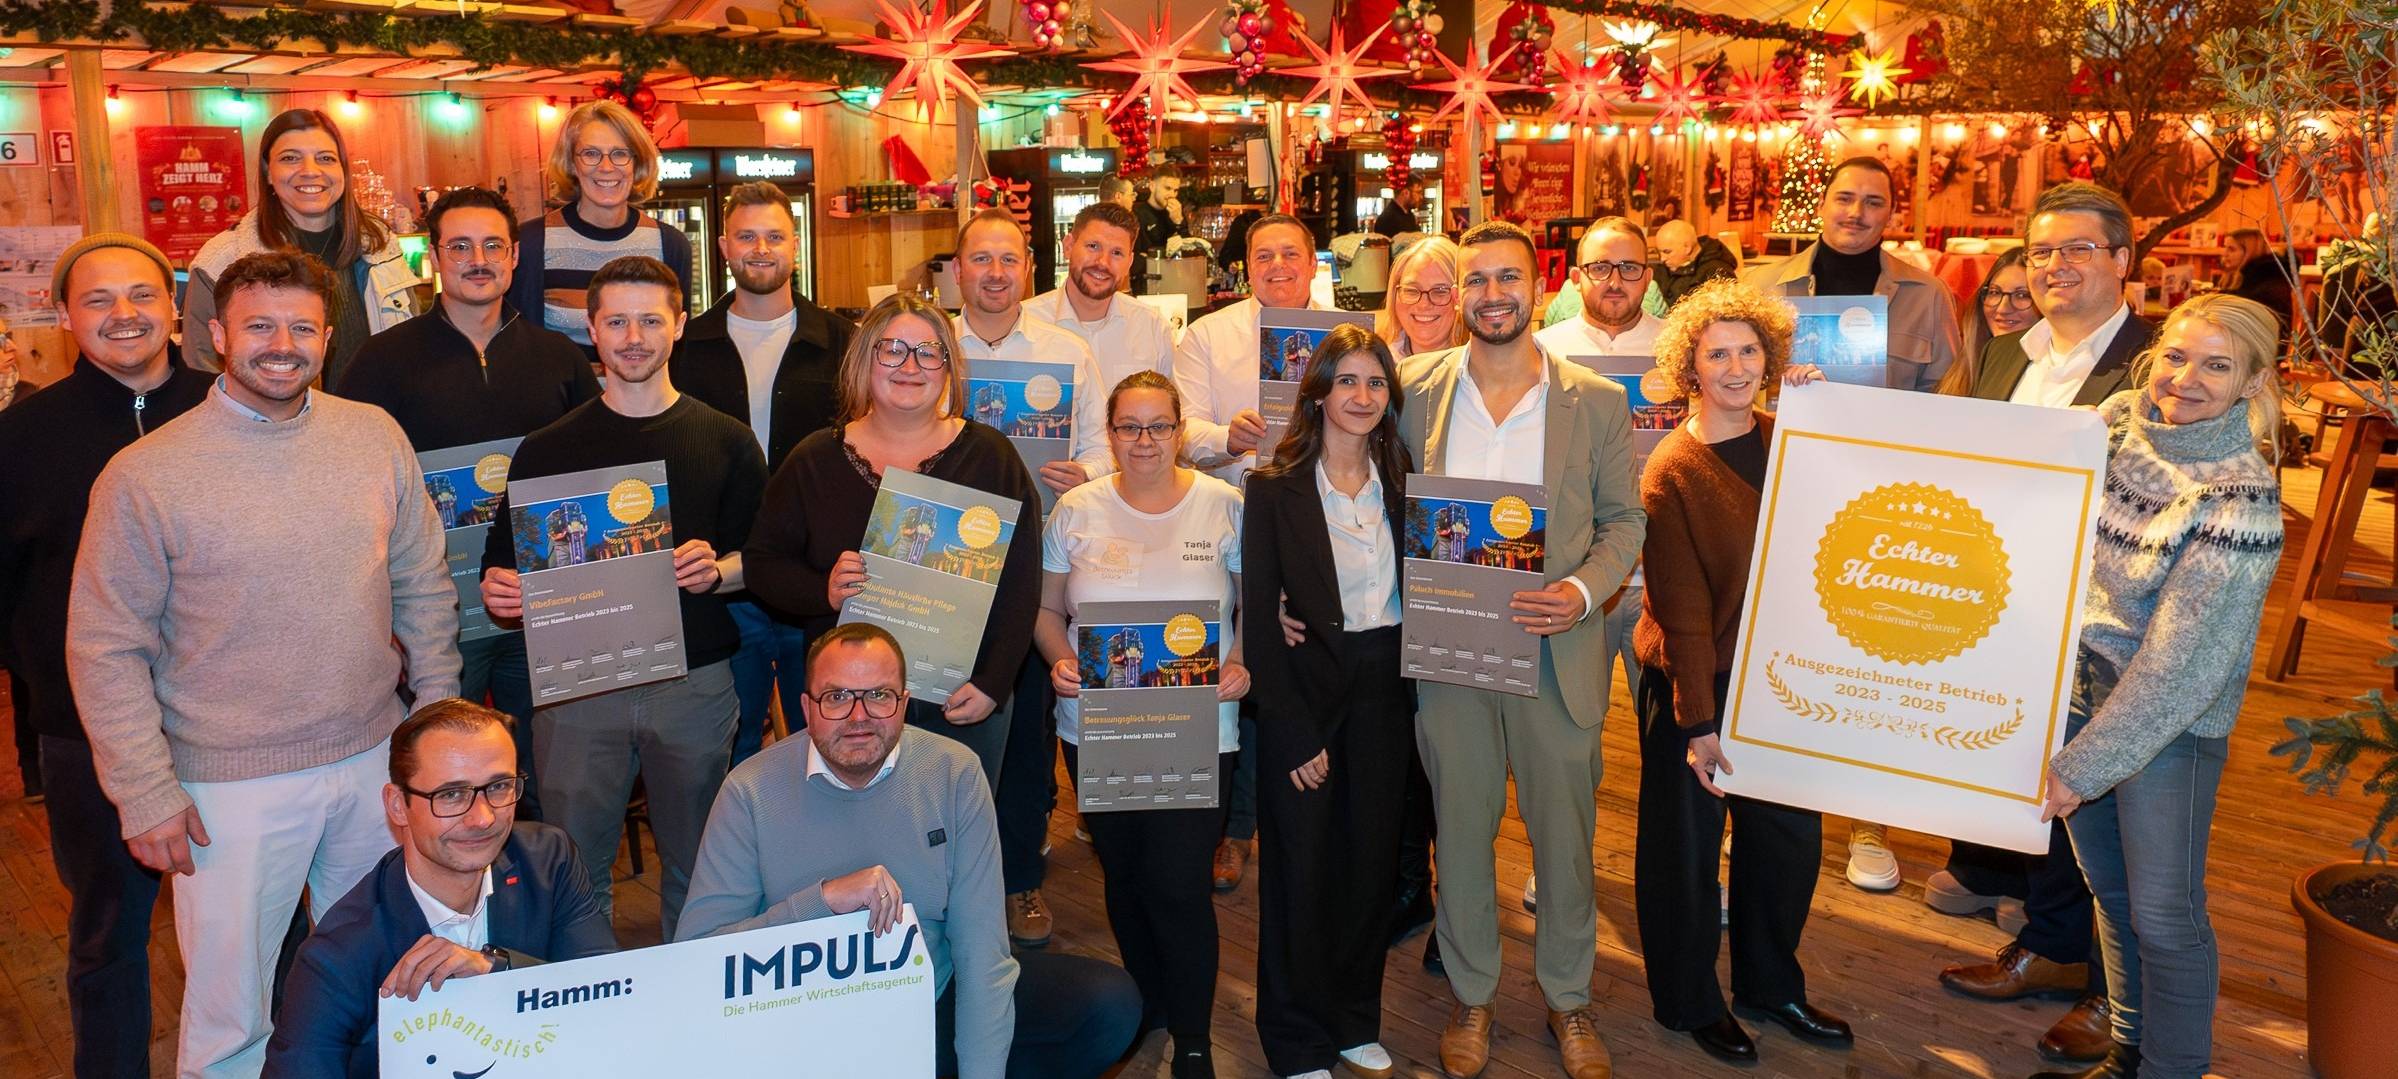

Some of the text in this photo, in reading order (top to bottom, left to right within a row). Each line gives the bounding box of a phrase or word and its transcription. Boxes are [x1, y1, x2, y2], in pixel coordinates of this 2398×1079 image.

[175, 162, 209, 173] HAMM
[163, 172, 224, 184] ZEIGT HERZ
[1184, 541, 1211, 549] Tanja
[1868, 533, 1960, 568] Echter
[1182, 554, 1215, 562] Glaser
[863, 582, 897, 598] mbulante
[1835, 558, 1985, 604] Hammer
[578, 588, 604, 601] GmbH
[531, 619, 550, 629] Echter
[550, 615, 574, 625] Hammer
[575, 611, 595, 621] Betrieb
[595, 607, 610, 616] 2023
[610, 605, 619, 614] bis
[620, 603, 633, 612] 2025
[849, 606, 865, 616] Echter
[865, 609, 886, 621] Hammer
[886, 615, 905, 625] Betrieb
[1409, 602, 1425, 610] Echter
[1425, 604, 1446, 613] Hammer
[1446, 607, 1465, 615] Betrieb
[1784, 653, 2008, 707] Ausgezeichneter Betrieb
[1834, 683, 1881, 701] 2023
[1900, 695, 1947, 714] 2025
[1084, 714, 1191, 726] Betreuungsglück Tanja Glaser
[516, 977, 633, 1014] Hamm:
[723, 973, 924, 1018] Die Hammer Wirtschaftsagentur
[393, 1007, 560, 1059] elephantastisch!
